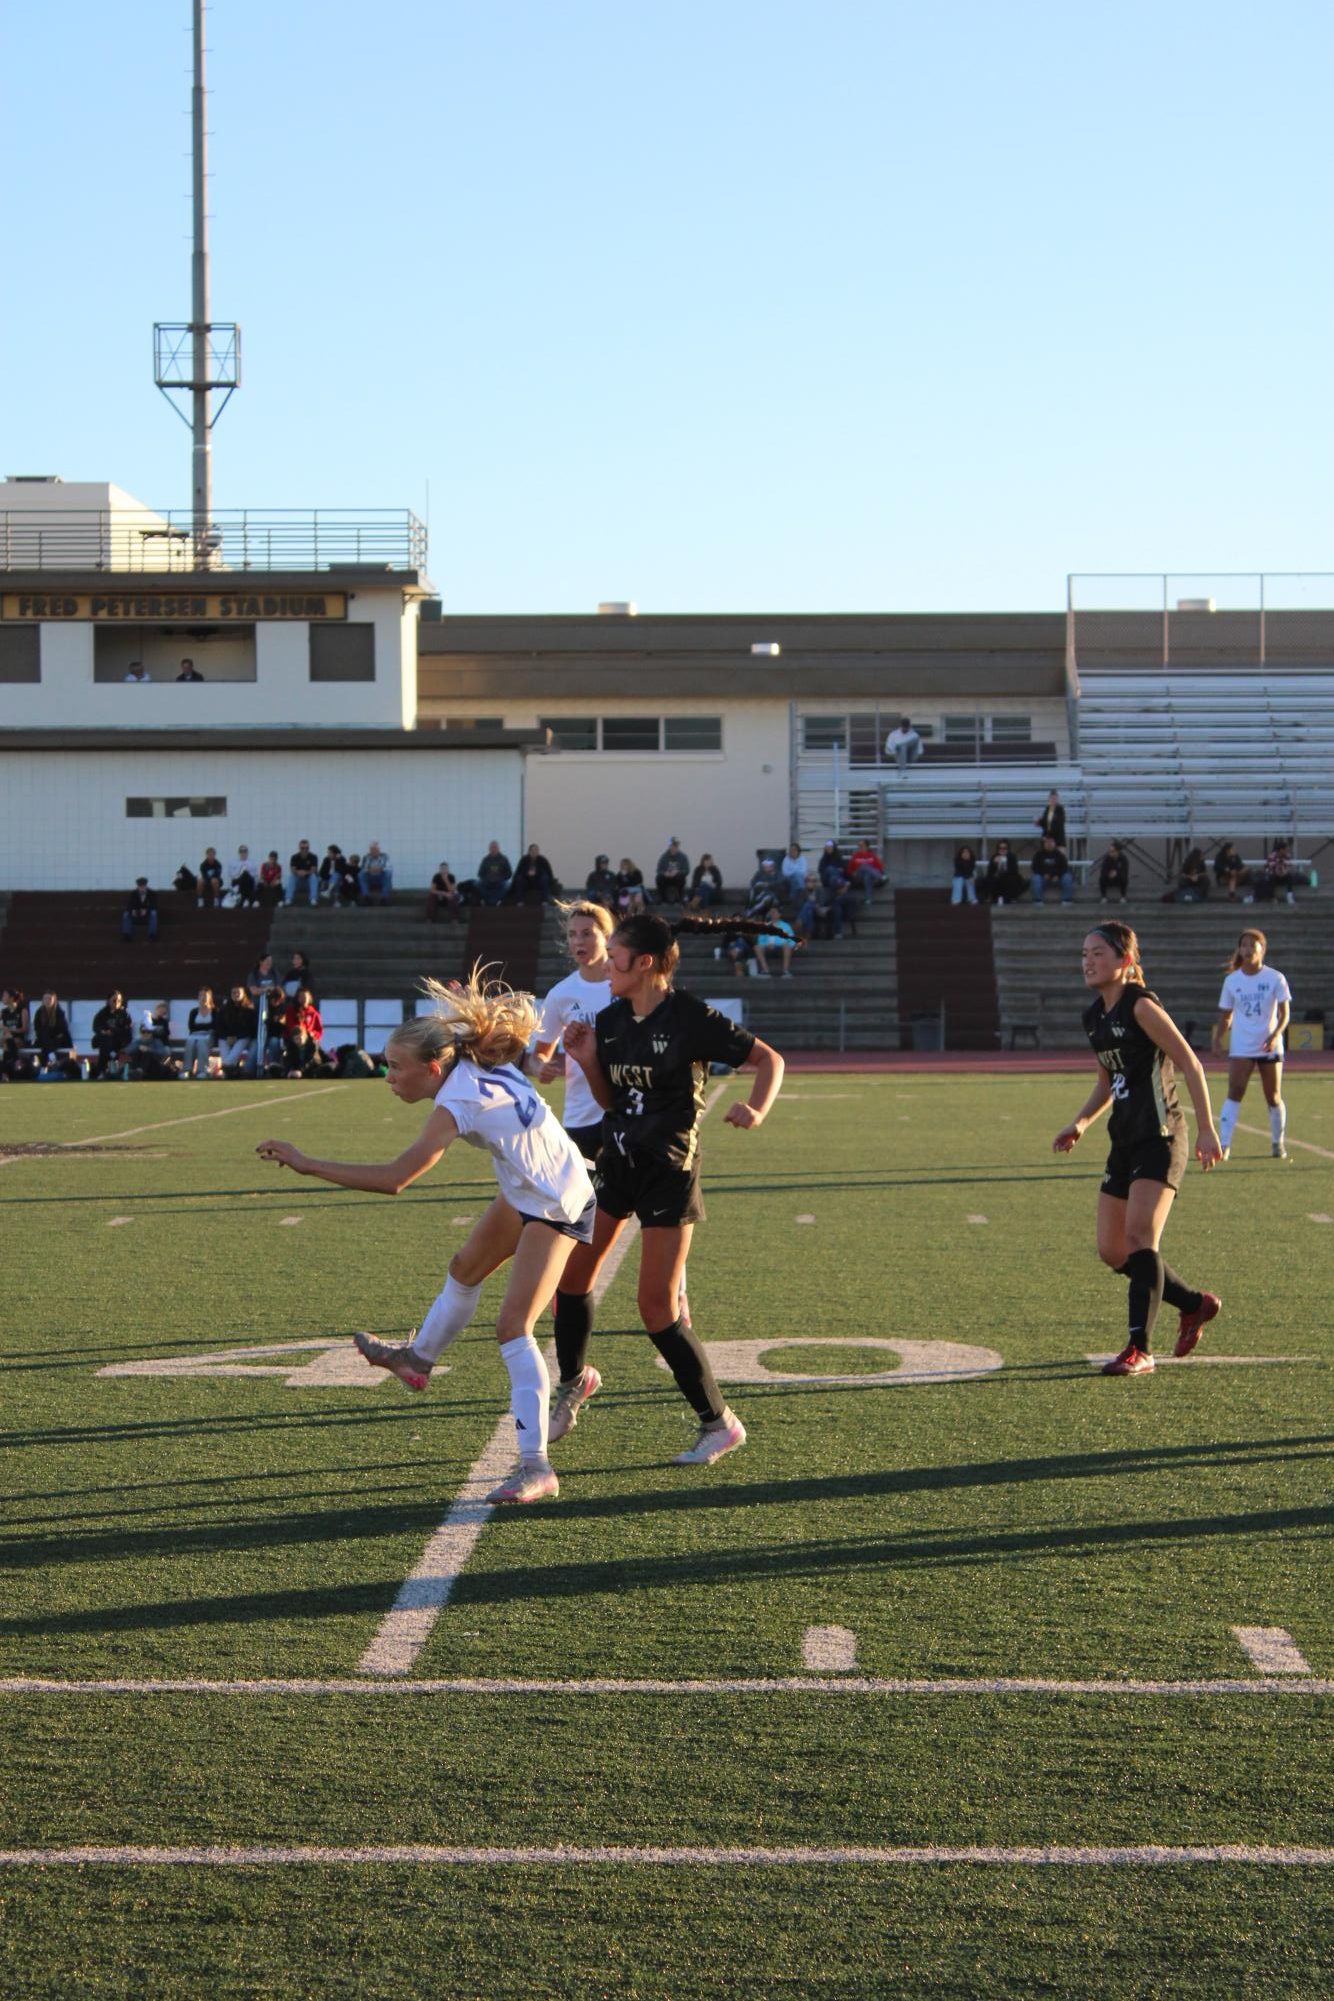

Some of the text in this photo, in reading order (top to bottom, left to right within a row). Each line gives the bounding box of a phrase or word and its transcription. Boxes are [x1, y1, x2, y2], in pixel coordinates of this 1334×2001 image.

[18, 596, 328, 617] FRED PETERSEN STADIUM
[1243, 1001, 1262, 1017] 24
[609, 1063, 653, 1089] WEST
[626, 1087, 645, 1115] 3
